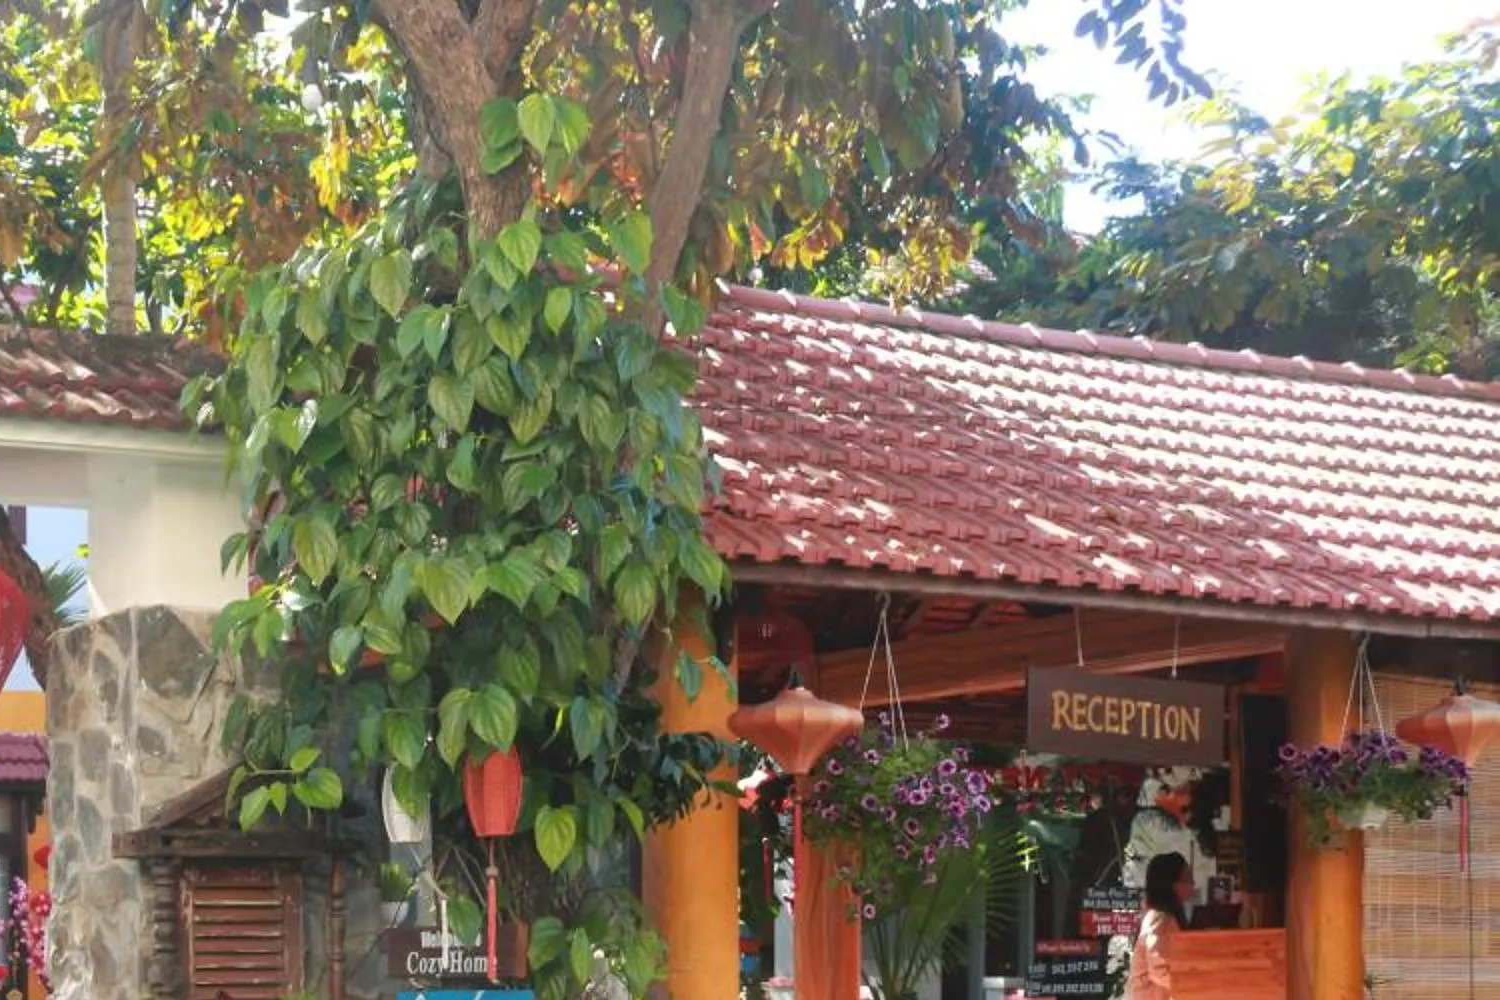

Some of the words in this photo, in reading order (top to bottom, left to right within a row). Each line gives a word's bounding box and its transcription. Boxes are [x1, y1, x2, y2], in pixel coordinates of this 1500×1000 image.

[1051, 690, 1201, 742] RECEPTION
[406, 952, 445, 979] Cozy
[449, 950, 498, 974] Hom
